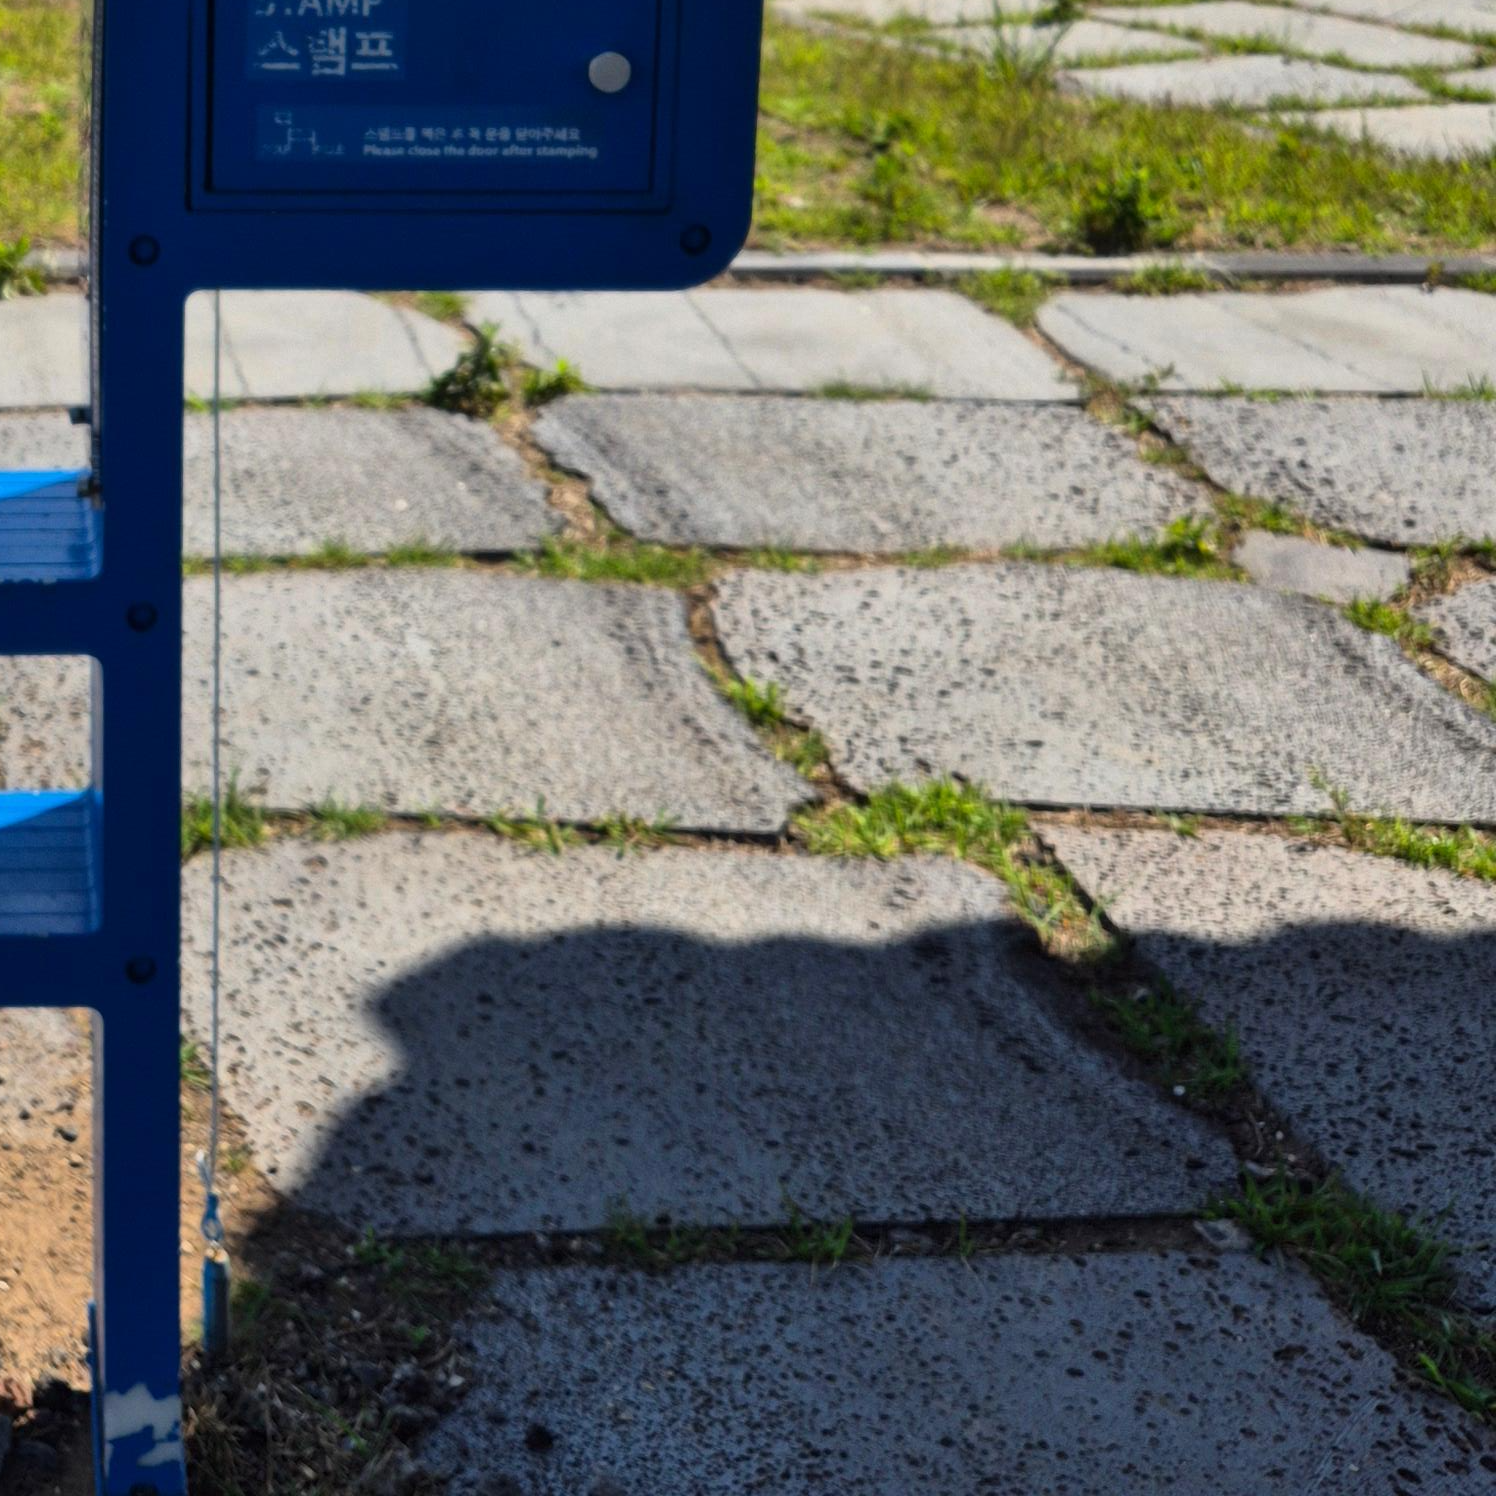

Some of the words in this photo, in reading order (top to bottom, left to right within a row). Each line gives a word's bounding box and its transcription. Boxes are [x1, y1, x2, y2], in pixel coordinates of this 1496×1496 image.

[255, 26, 399, 76] 스탬프
[363, 144, 404, 156] Please
[408, 144, 441, 156] close
[444, 144, 466, 156] the
[468, 144, 499, 156] door
[502, 144, 534, 156] after
[536, 144, 598, 159] stamping
